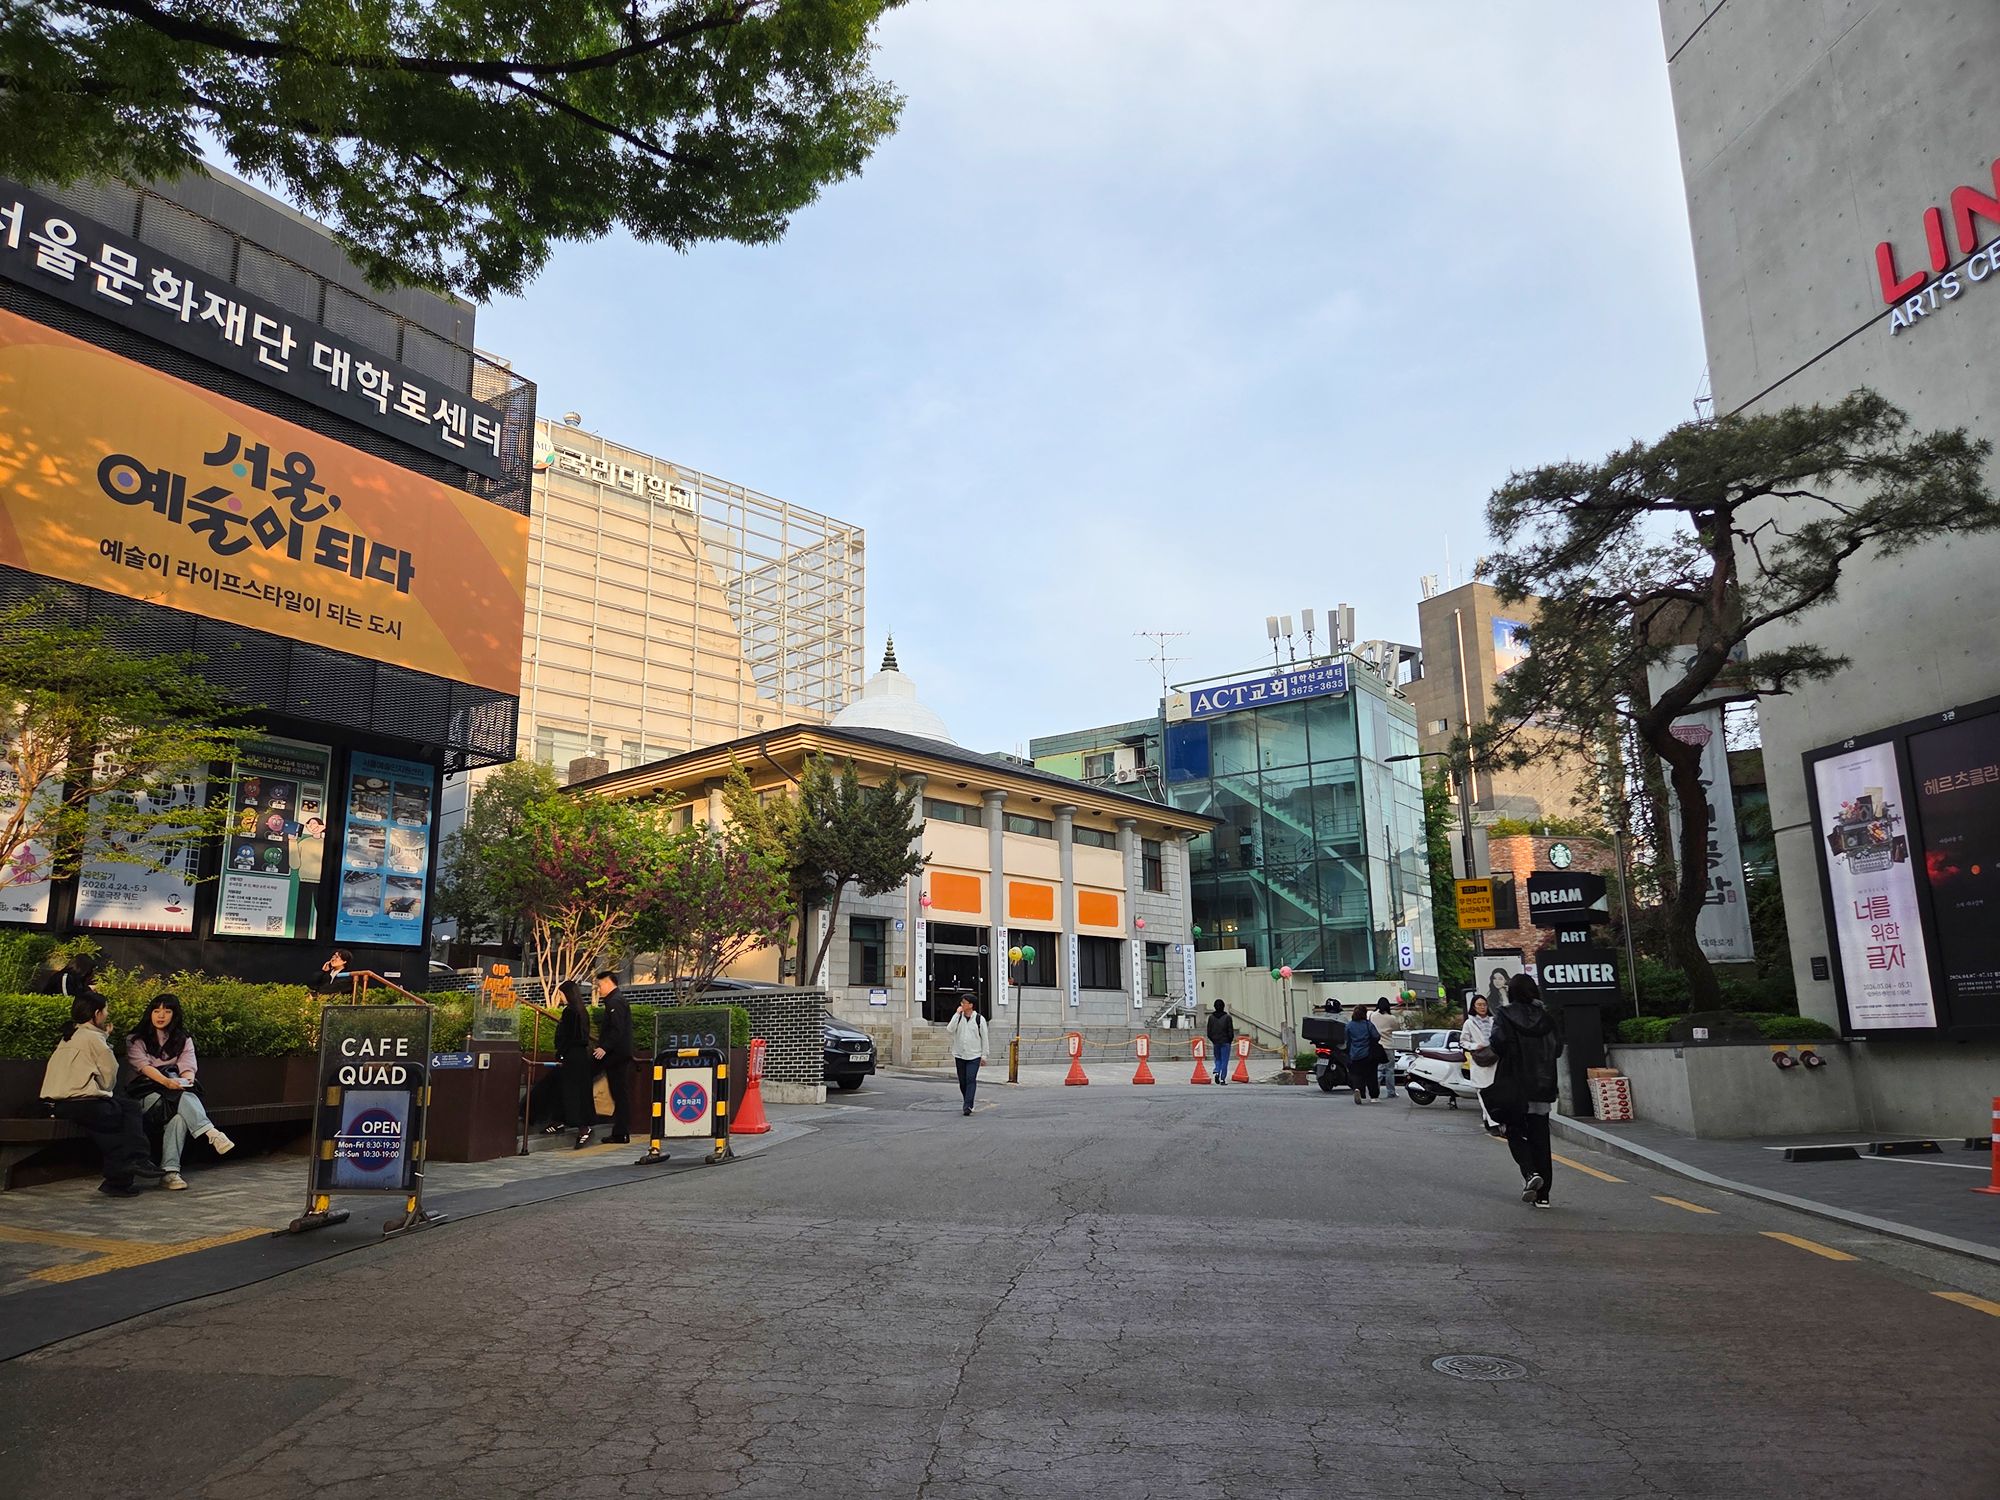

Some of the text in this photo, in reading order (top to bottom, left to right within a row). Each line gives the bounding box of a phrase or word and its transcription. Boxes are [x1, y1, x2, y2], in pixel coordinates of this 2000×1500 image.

[1889, 271, 1961, 337] ARTS
[313, 340, 500, 458] 대학로센터
[203, 432, 341, 522] 서울,
[560, 446, 696, 512] 국민대학교
[314, 525, 415, 595] 되다
[100, 538, 402, 640] 예술이 라이프스타일이 되는 도시
[1290, 667, 1343, 686] 대학선교센터
[1194, 678, 1288, 712] ACT교회
[1291, 680, 1344, 696] 3675-3635
[1942, 710, 1956, 721] 3관
[1923, 765, 2000, 795] 헤르츠클란
[81, 890, 121, 900] 대학로극장
[1530, 888, 1583, 905] DREAM
[1853, 895, 1891, 921] 너를
[1561, 931, 1587, 943] ART
[1871, 922, 1900, 942] 위한
[1866, 944, 1906, 971] 글자
[1543, 964, 1615, 983] CENTER
[341, 1038, 409, 1057] CAFE
[338, 1065, 407, 1086] QUAD
[676, 1098, 702, 1106] 주정차금지
[361, 1121, 401, 1134] OPEN
[334, 1150, 400, 1158] Sat-Sun 10:30-19:00
[338, 1141, 400, 1149] Mon-Fri 8:30-19:30
